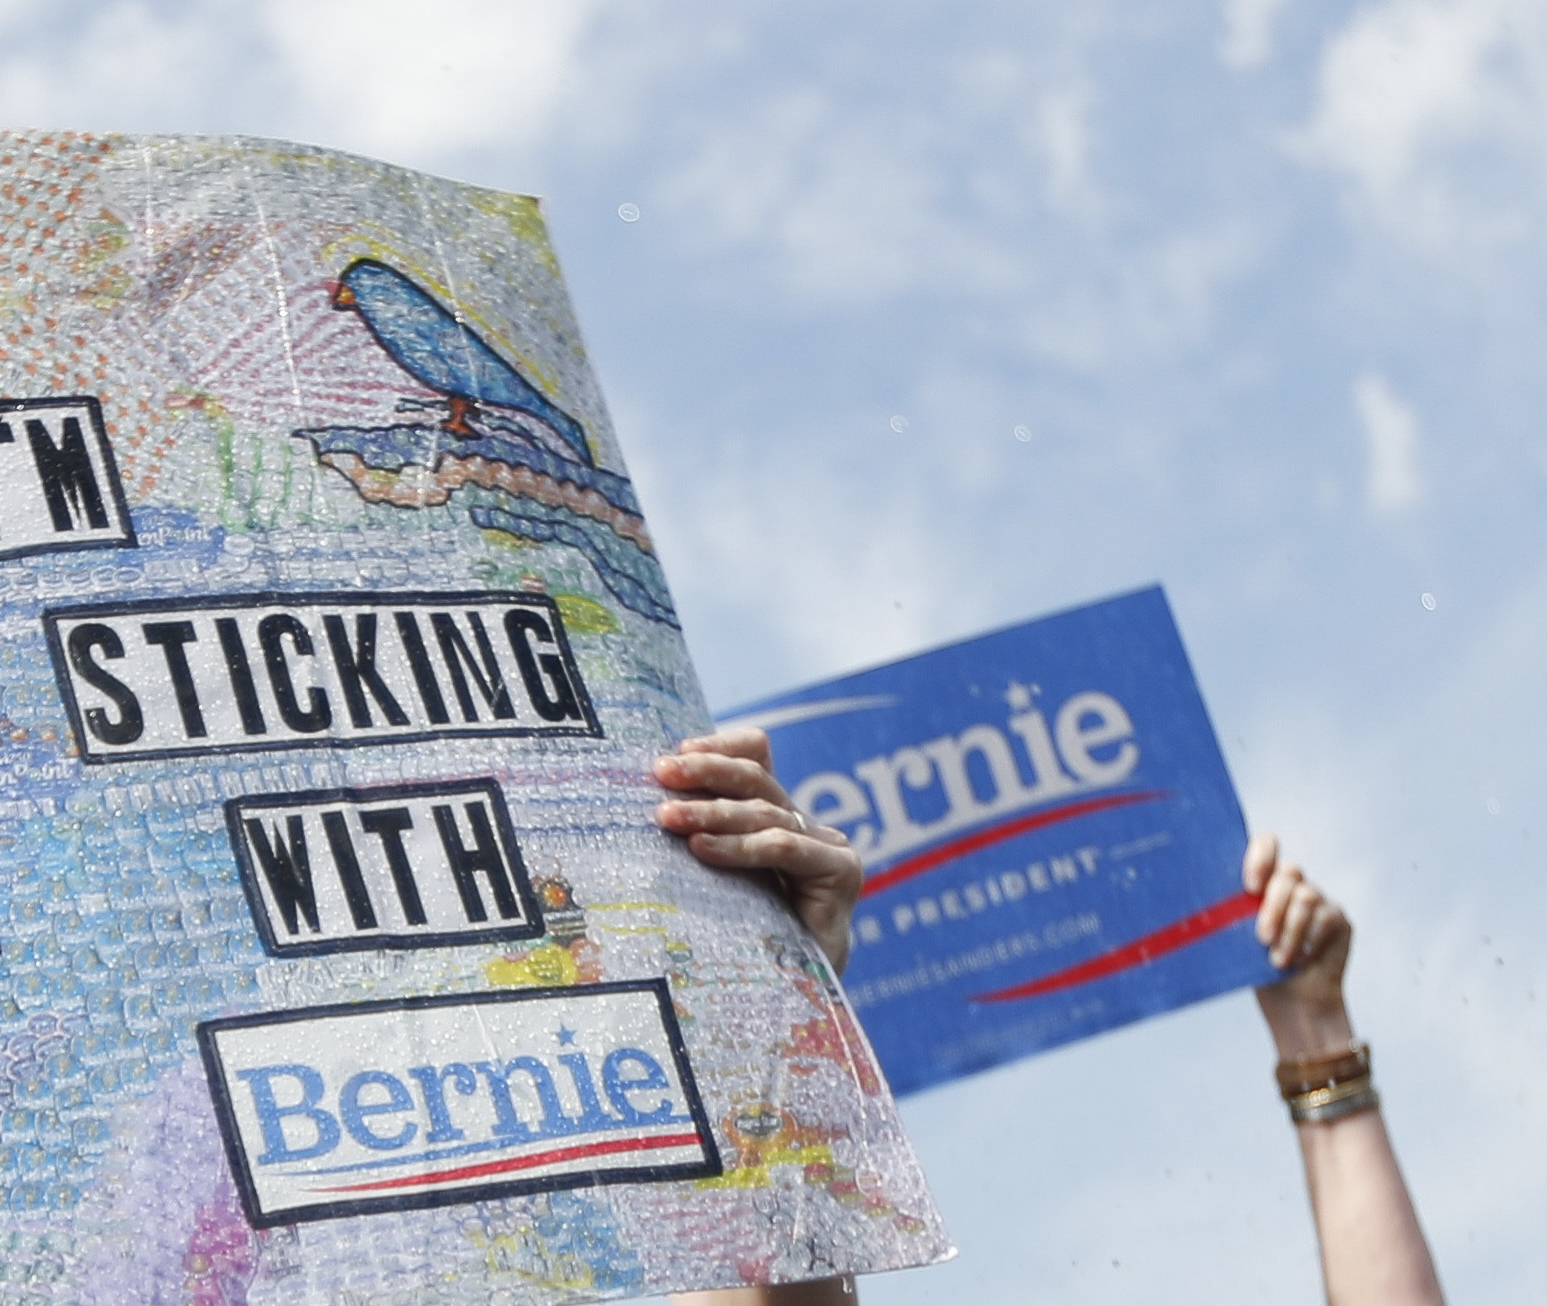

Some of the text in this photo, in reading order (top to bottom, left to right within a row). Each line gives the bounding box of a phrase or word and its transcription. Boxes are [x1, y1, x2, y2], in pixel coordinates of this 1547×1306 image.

[64, 606, 583, 747] STICKING
[793, 681, 1140, 868] ernie
[242, 801, 522, 938] WITH
[891, 845, 1100, 935] PRESIDENT
[238, 1027, 682, 1167] Bernie
